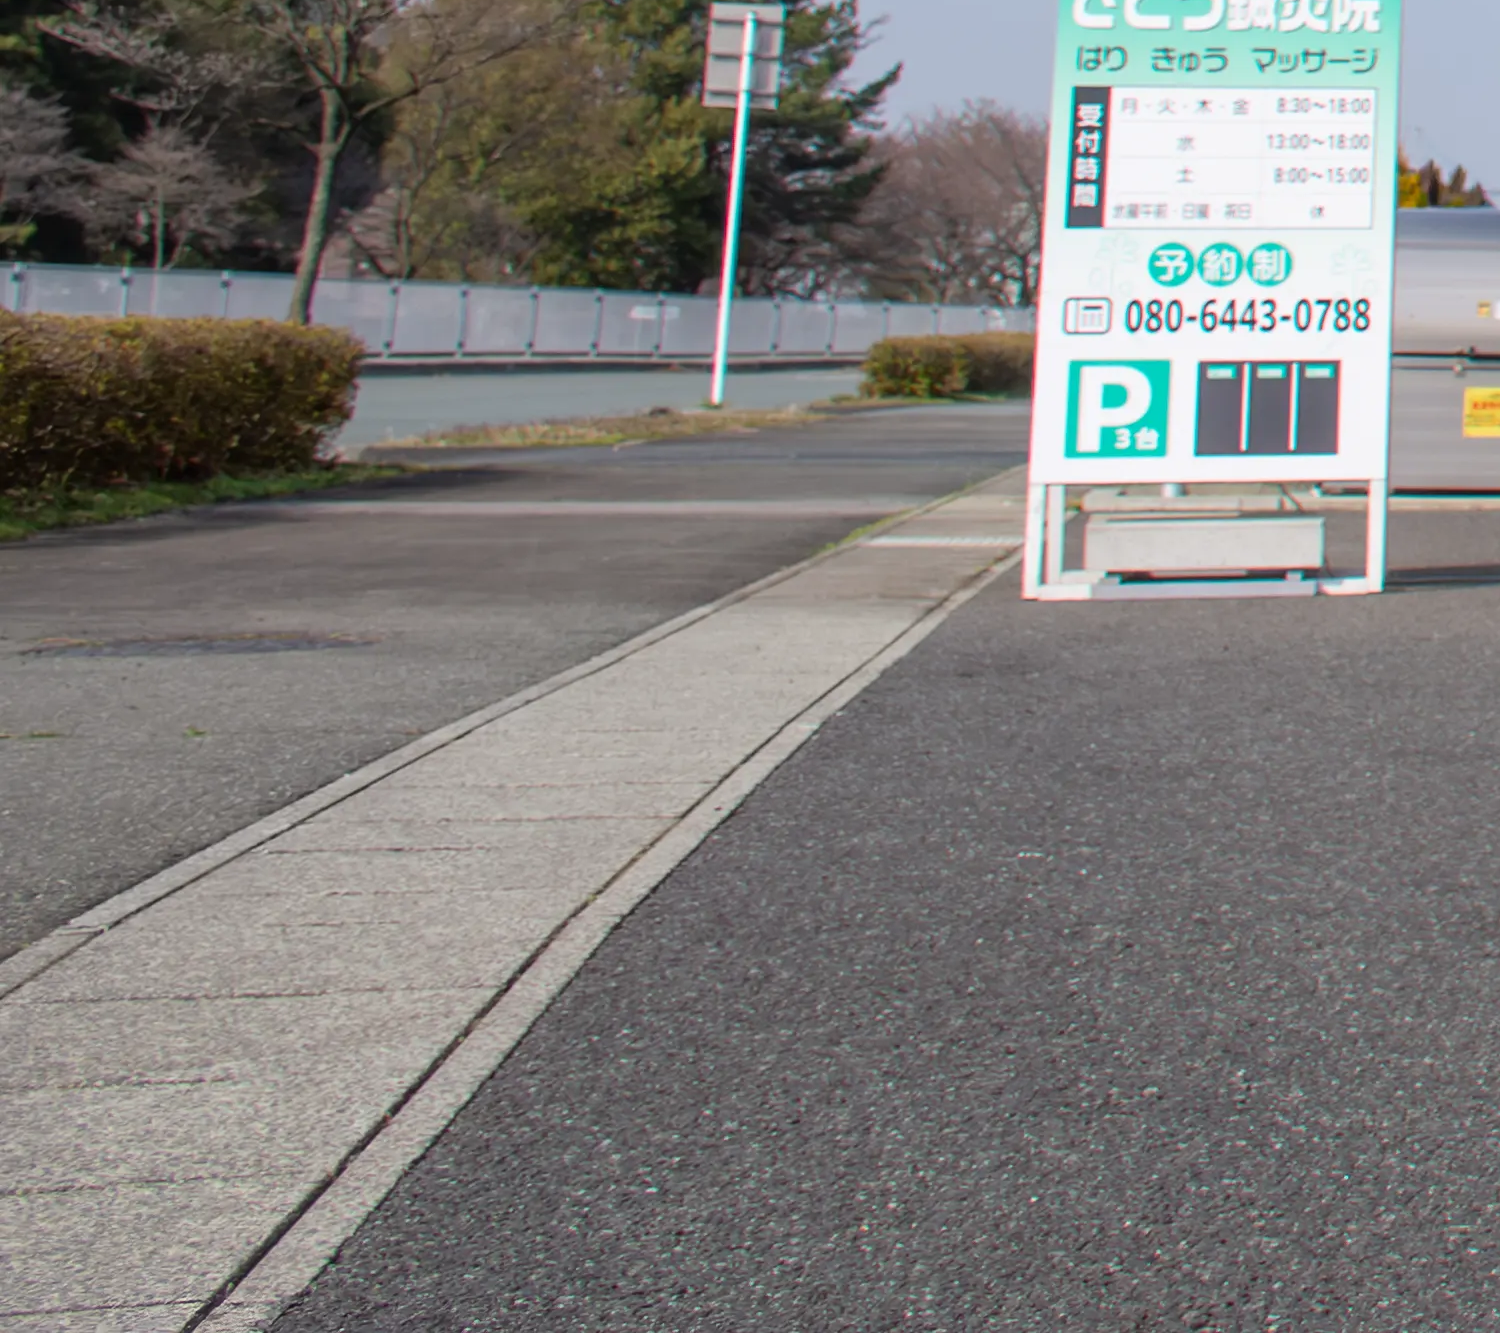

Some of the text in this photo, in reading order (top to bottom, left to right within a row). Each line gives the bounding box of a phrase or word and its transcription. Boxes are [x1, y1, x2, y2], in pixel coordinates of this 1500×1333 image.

[1076, 45, 1379, 73] はり きゅう マッサージ
[1176, 167, 1195, 183] 土
[1153, 249, 1286, 282] 予約制
[1124, 298, 1371, 333] 080-6443-0788
[1076, 365, 1152, 453] P
[1114, 427, 1159, 450] 3台
